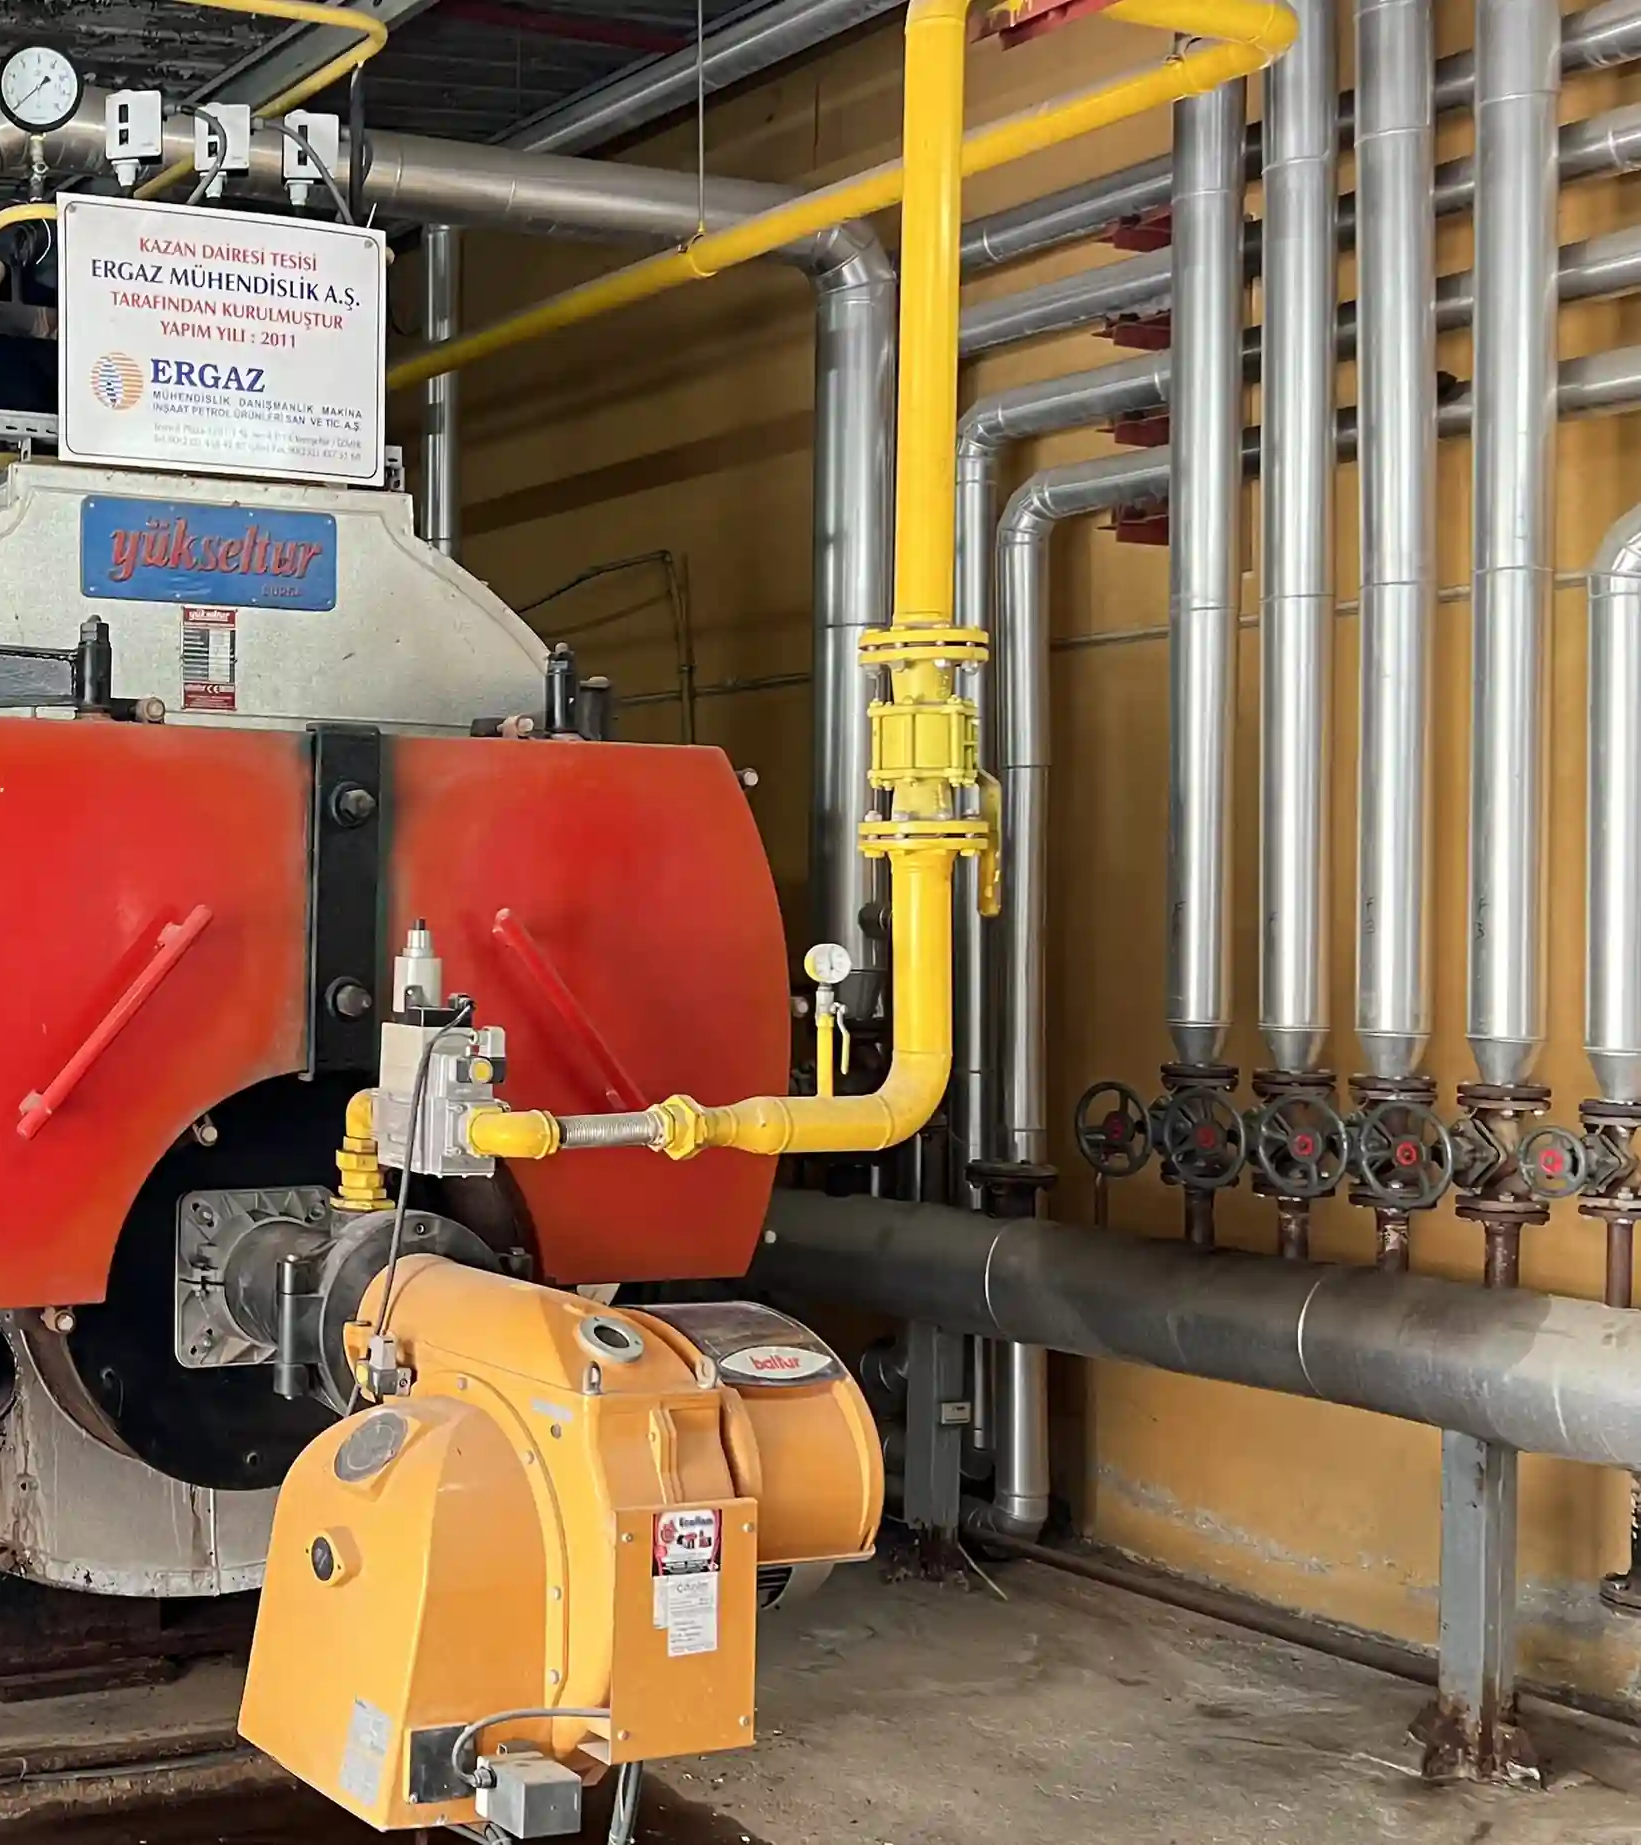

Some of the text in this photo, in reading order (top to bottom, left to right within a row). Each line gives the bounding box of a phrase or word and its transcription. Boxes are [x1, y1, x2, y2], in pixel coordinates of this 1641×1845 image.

[140, 237, 317, 271] KAZAN DAİRESİ TESİSİ
[91, 259, 360, 311] ERGAZ MÜHENDİSLİK A.Ş.
[110, 291, 343, 330] TARAFINDAN KURULMUŞTUR
[160, 320, 211, 339] YAPIM
[217, 326, 245, 342] YILI
[260, 331, 296, 348] 2011
[150, 358, 265, 392] ERGAZ
[310, 417, 323, 427] VE
[110, 516, 323, 582] yükseltur
